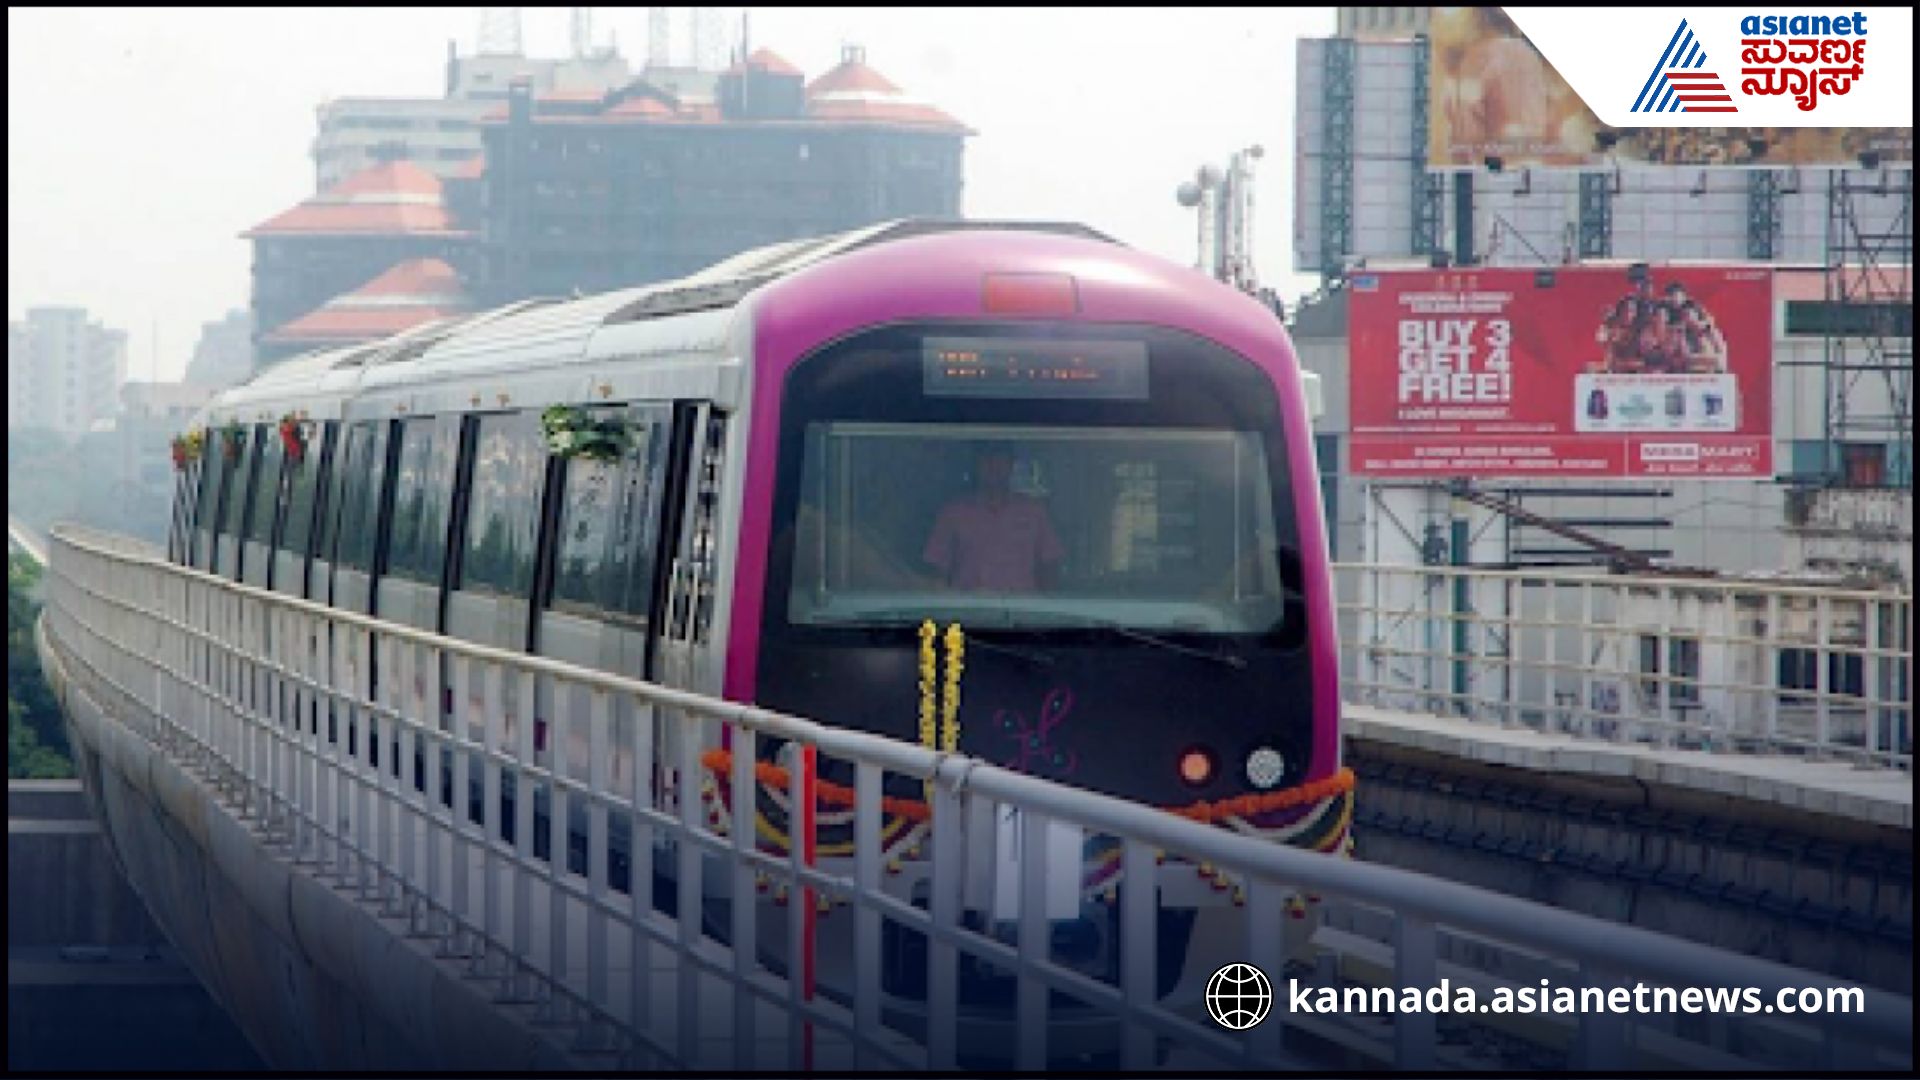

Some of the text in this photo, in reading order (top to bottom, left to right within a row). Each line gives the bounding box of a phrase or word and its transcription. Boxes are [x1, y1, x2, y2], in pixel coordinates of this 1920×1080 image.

[1398, 320, 1510, 346] BUY 3
[1398, 346, 1510, 373] GET 4
[1398, 373, 1510, 402] FREE!
